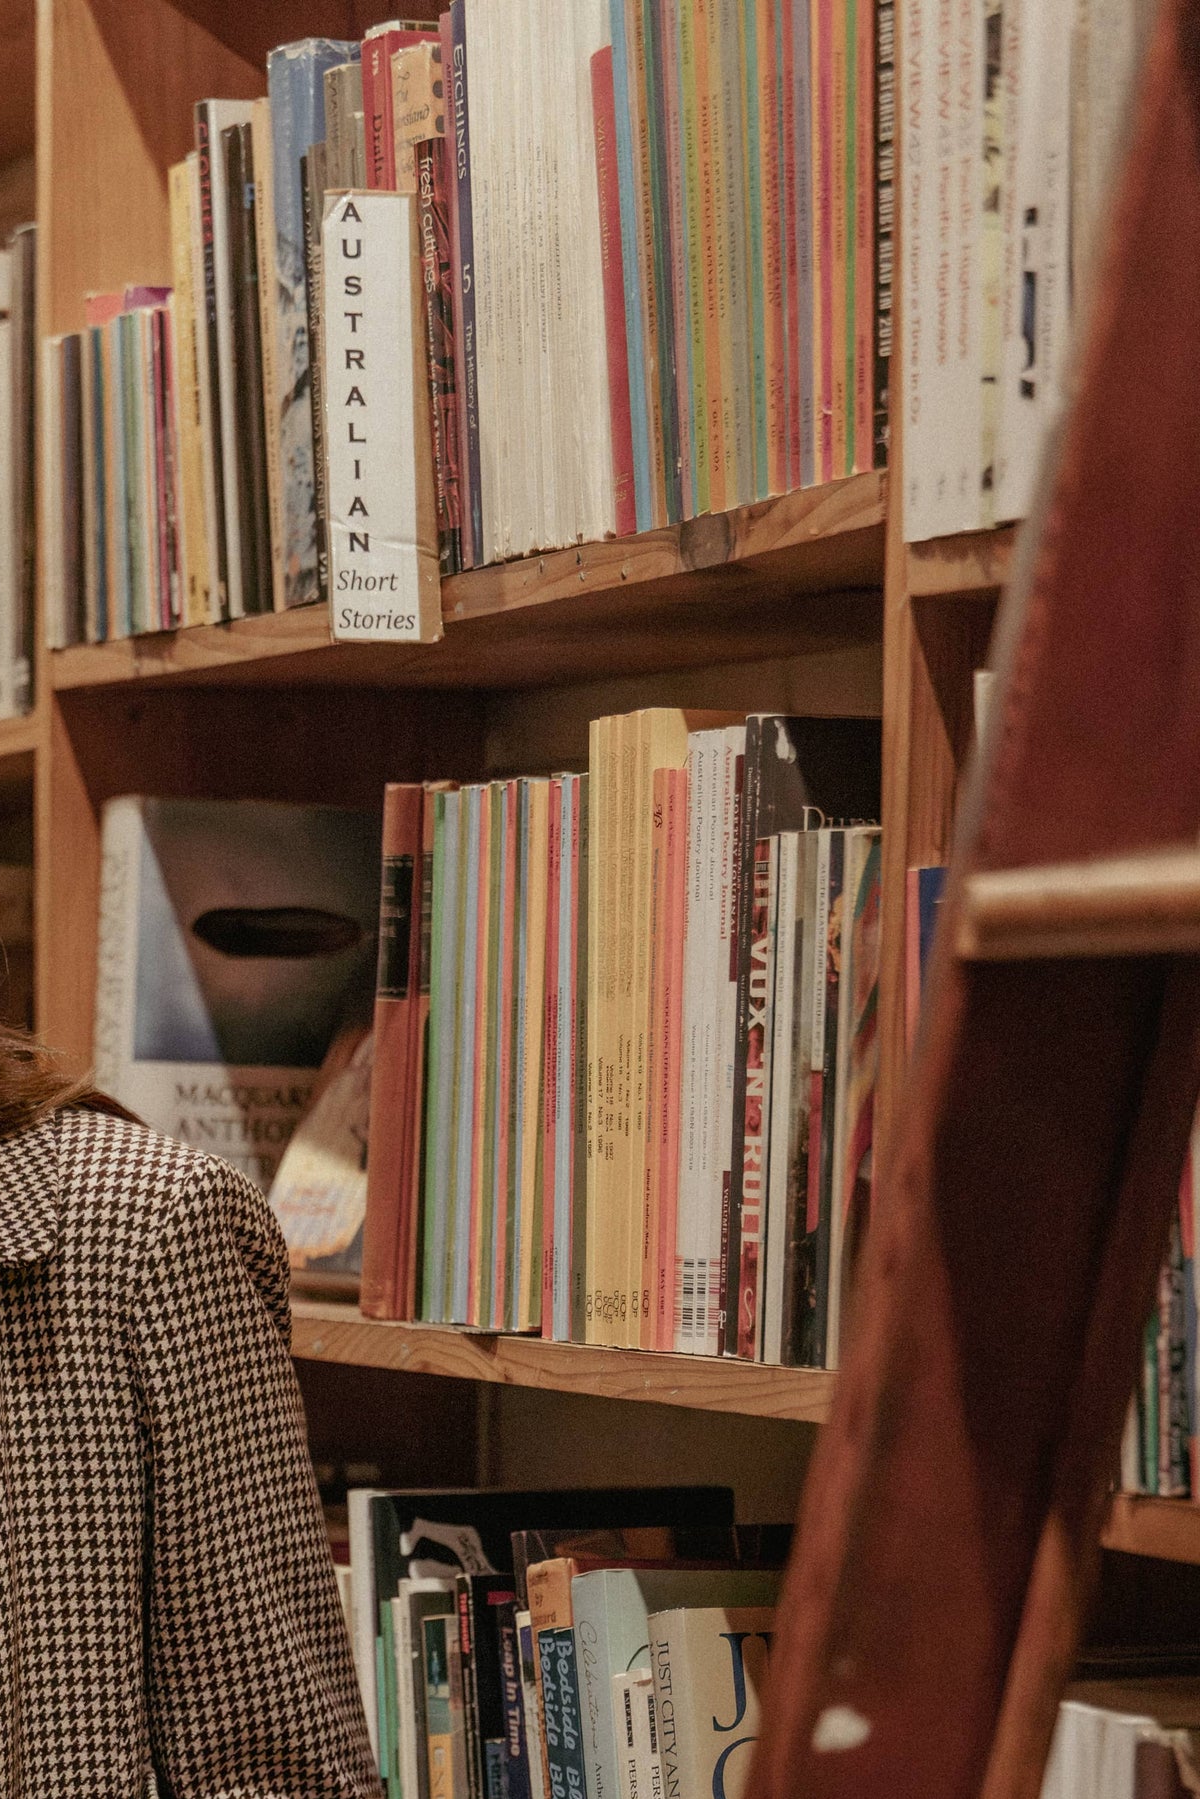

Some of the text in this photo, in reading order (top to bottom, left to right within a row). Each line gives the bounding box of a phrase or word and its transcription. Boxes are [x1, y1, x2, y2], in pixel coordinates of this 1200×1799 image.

[452, 43, 467, 181] ETCHINGS
[418, 157, 438, 295] fresh cuttings
[462, 264, 471, 294] 5
[465, 324, 474, 353] The
[340, 201, 371, 553] AUSTRALIAN
[466, 356, 477, 409] History
[337, 569, 398, 593] Short
[339, 608, 416, 631] Stories
[696, 750, 704, 812] Australian
[711, 748, 719, 811] Australian
[694, 816, 703, 856] Poetry
[710, 814, 718, 854] Poetry
[720, 745, 733, 941] Australian Poetry Journal
[747, 934, 767, 1031] VUX
[538, 1637, 558, 1747] Bedside
[555, 1640, 576, 1750] Bedside
[656, 1639, 673, 1696] JUST
[507, 1706, 521, 1758] Time
[660, 1699, 678, 1757] CITY
